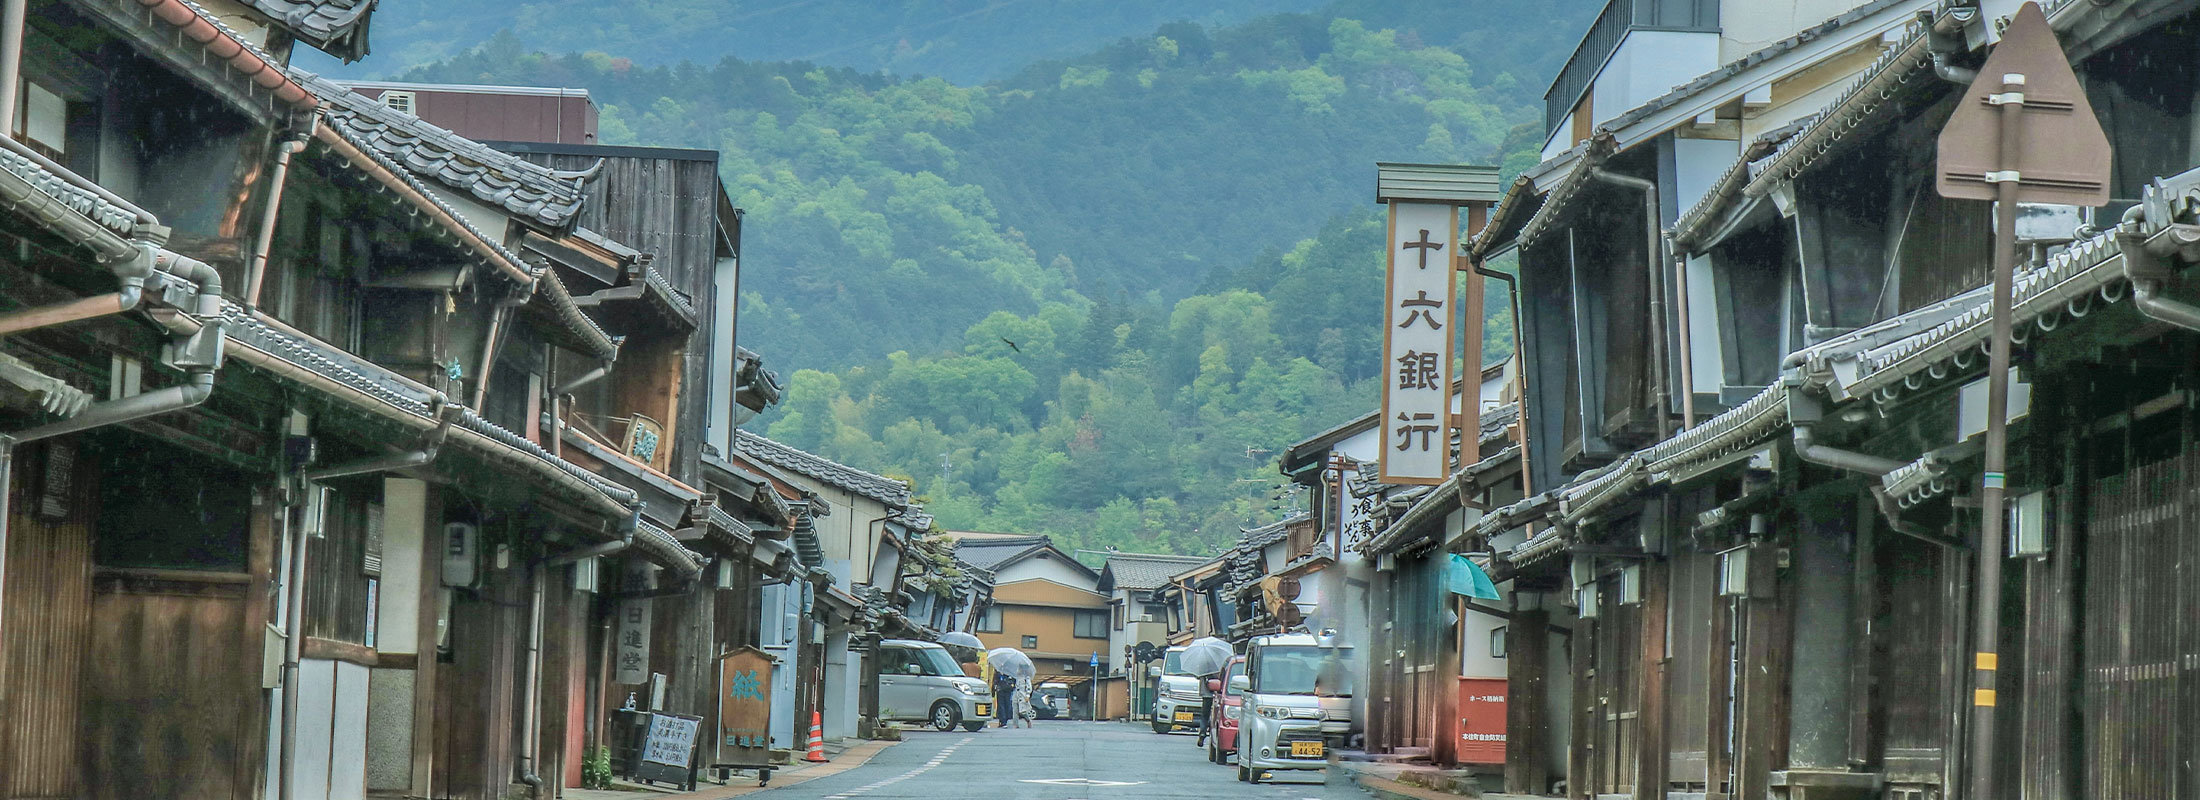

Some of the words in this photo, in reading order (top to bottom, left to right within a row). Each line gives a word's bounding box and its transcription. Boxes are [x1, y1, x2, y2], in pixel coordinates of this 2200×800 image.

[1396, 229, 1444, 452] 十六銀行
[1343, 523, 1353, 553] そば
[1350, 504, 1360, 542] うどん
[1358, 496, 1373, 557] 食事
[622, 606, 643, 672] 日進堂
[730, 669, 764, 702] 紙
[726, 735, 765, 748] 日進堂
[1298, 747, 1321, 756] 44-52
